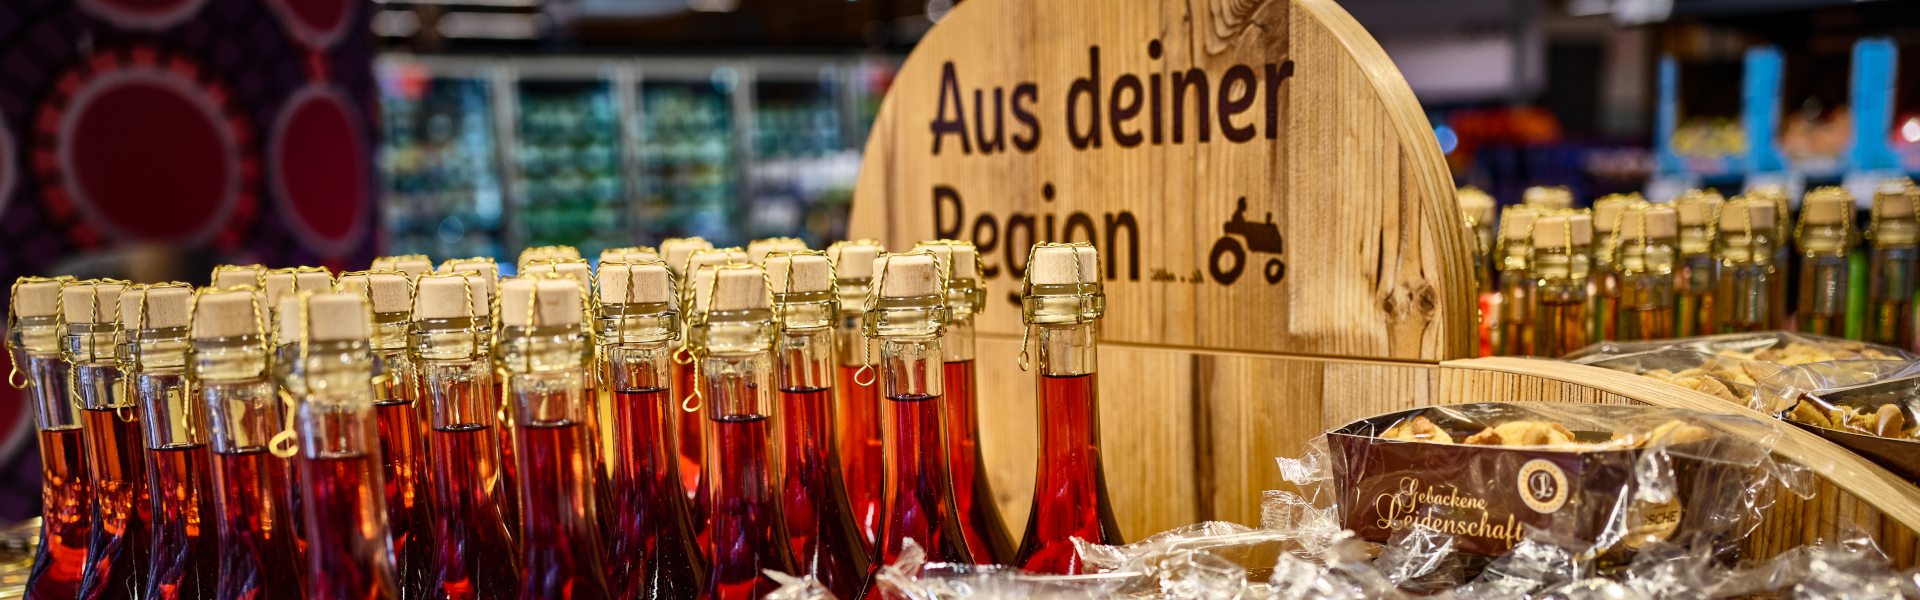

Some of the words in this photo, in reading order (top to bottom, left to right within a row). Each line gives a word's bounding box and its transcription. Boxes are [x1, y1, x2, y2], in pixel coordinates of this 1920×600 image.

[930, 61, 1042, 155] Aus
[1067, 39, 1294, 150] deiner
[1376, 493, 1526, 550] Leidenschaft
[1398, 476, 1488, 514] Gebackene
